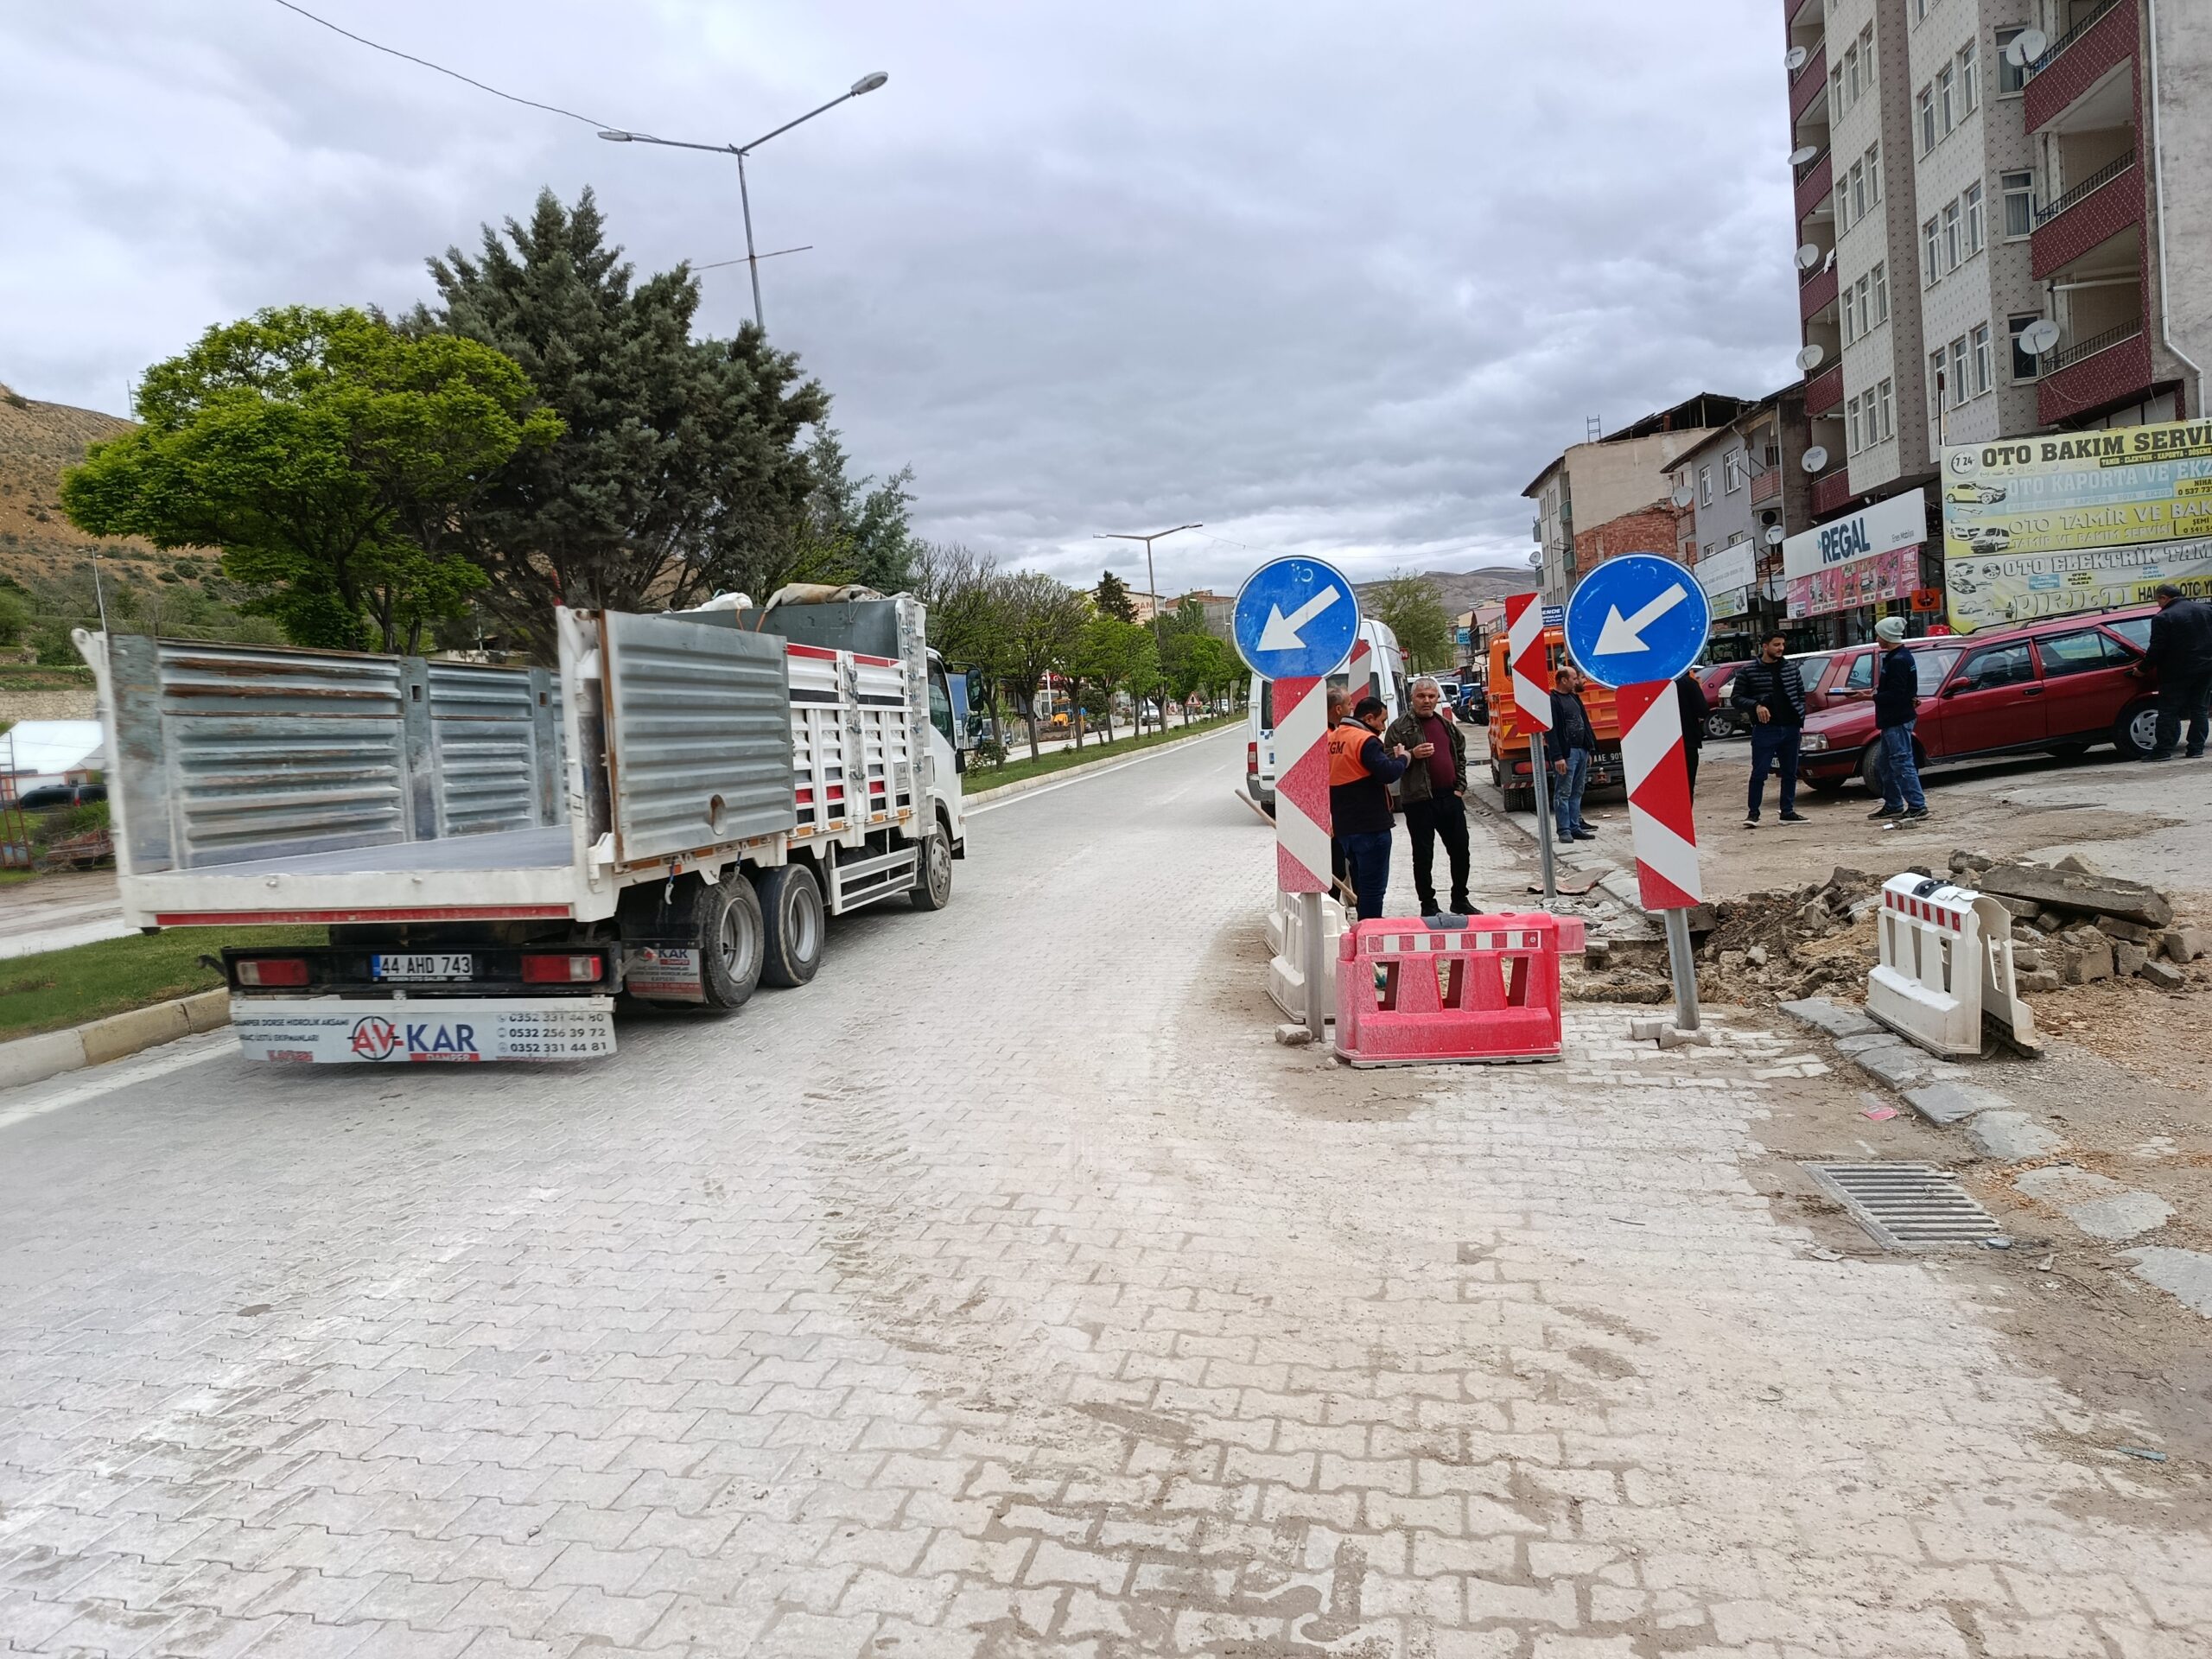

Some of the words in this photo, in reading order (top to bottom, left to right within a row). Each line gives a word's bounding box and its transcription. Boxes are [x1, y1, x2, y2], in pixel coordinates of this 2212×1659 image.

[1982, 445, 2031, 467] OTO
[2041, 435, 2125, 462] BAKIM
[2158, 451, 2183, 460] KAPORTA
[2008, 477, 2044, 497] OTO
[2052, 467, 2139, 492] KAPORTA
[2145, 463, 2170, 484] VE
[2009, 518, 2050, 535] OTO
[2059, 507, 2128, 531] TAMİR
[2133, 505, 2161, 523] VE
[1821, 518, 1871, 564] REGAL
[2056, 533, 2072, 544] VE
[2004, 557, 2045, 577] OTO
[2051, 546, 2160, 573] ELEKTRİK
[2180, 582, 2201, 597] OTO
[658, 949, 689, 958] KAR
[382, 957, 399, 974] 44
[407, 957, 434, 974] AHD
[442, 957, 470, 974] 743
[509, 1013, 539, 1022] 0352
[509, 1028, 539, 1038] 0532
[543, 1028, 566, 1038] 256
[569, 1028, 585, 1038] 39
[589, 1028, 607, 1037] 72
[510, 1043, 540, 1052] 0352
[543, 1043, 565, 1052] 331
[570, 1043, 587, 1052] 44
[591, 1042, 607, 1051] 81
